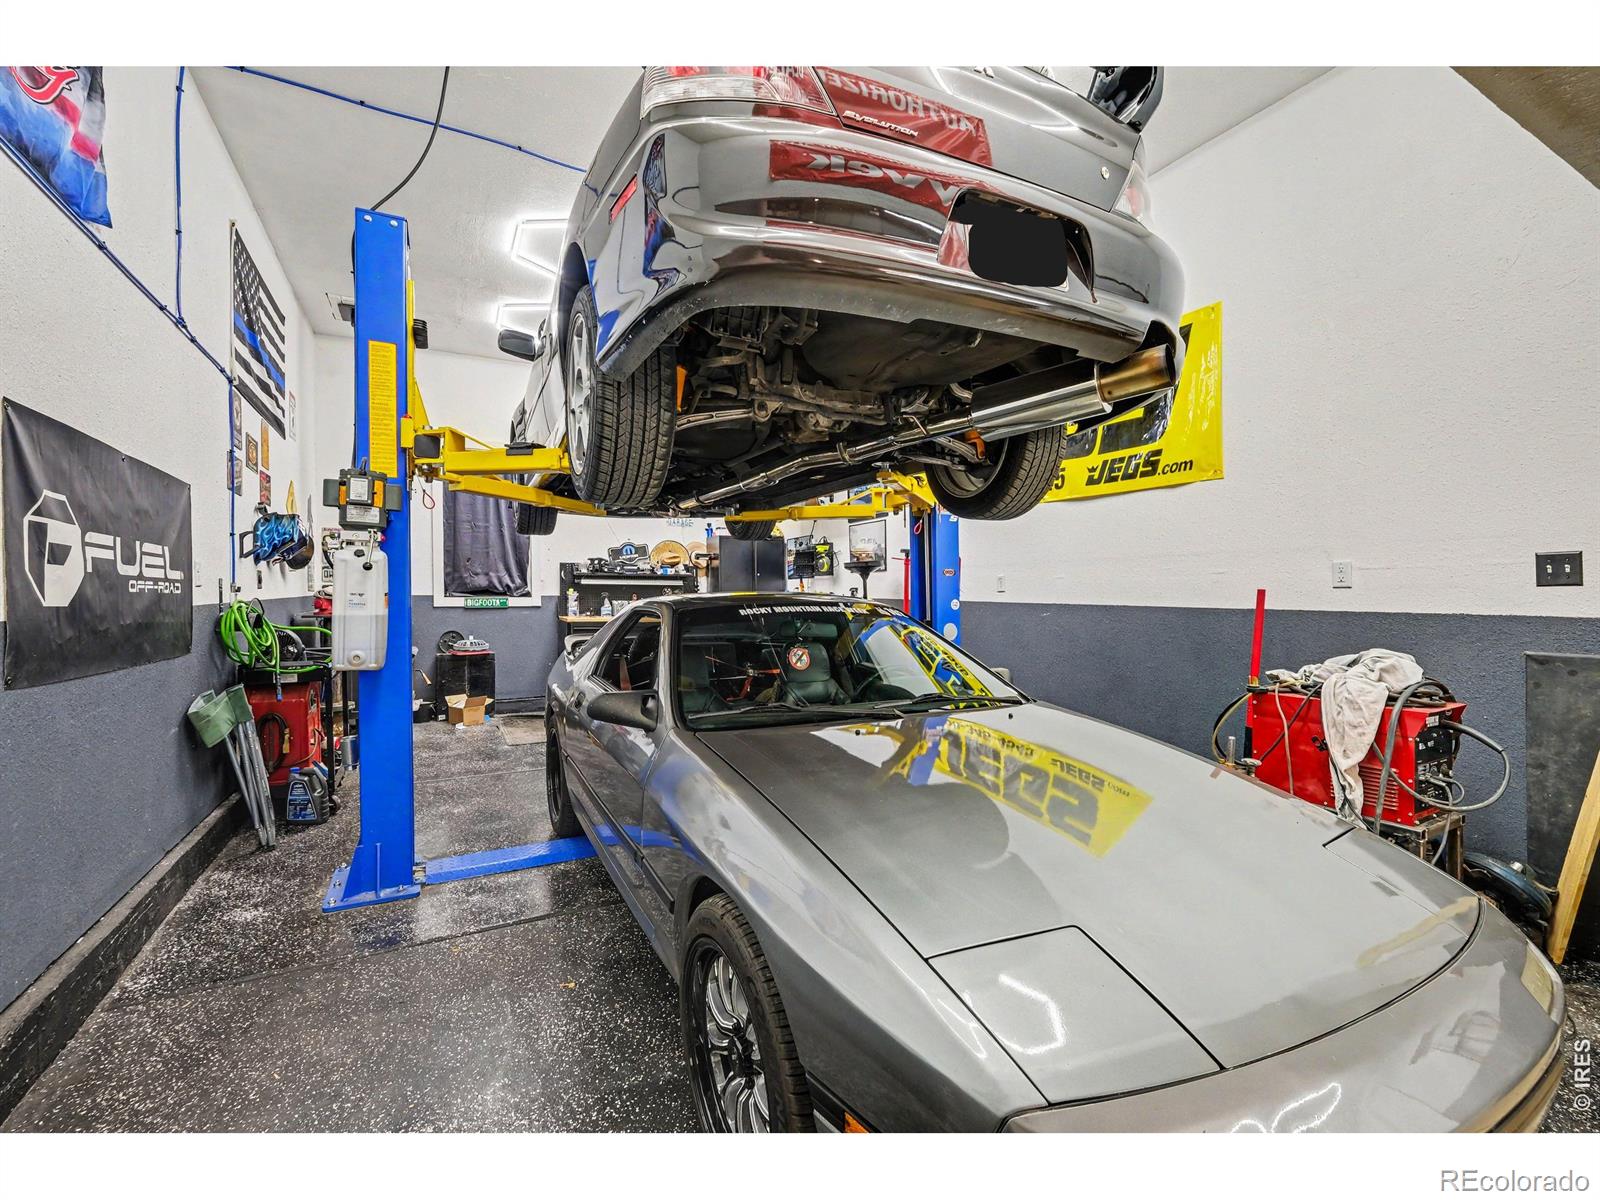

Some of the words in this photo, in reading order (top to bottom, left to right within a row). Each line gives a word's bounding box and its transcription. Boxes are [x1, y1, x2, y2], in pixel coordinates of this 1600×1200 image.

[843, 110, 918, 137] EVOLUTION
[1086, 449, 1193, 486] JEGS.com
[85, 531, 183, 579] FUEL
[128, 580, 182, 594] OFF-ROAD
[739, 606, 772, 616] ROCKY
